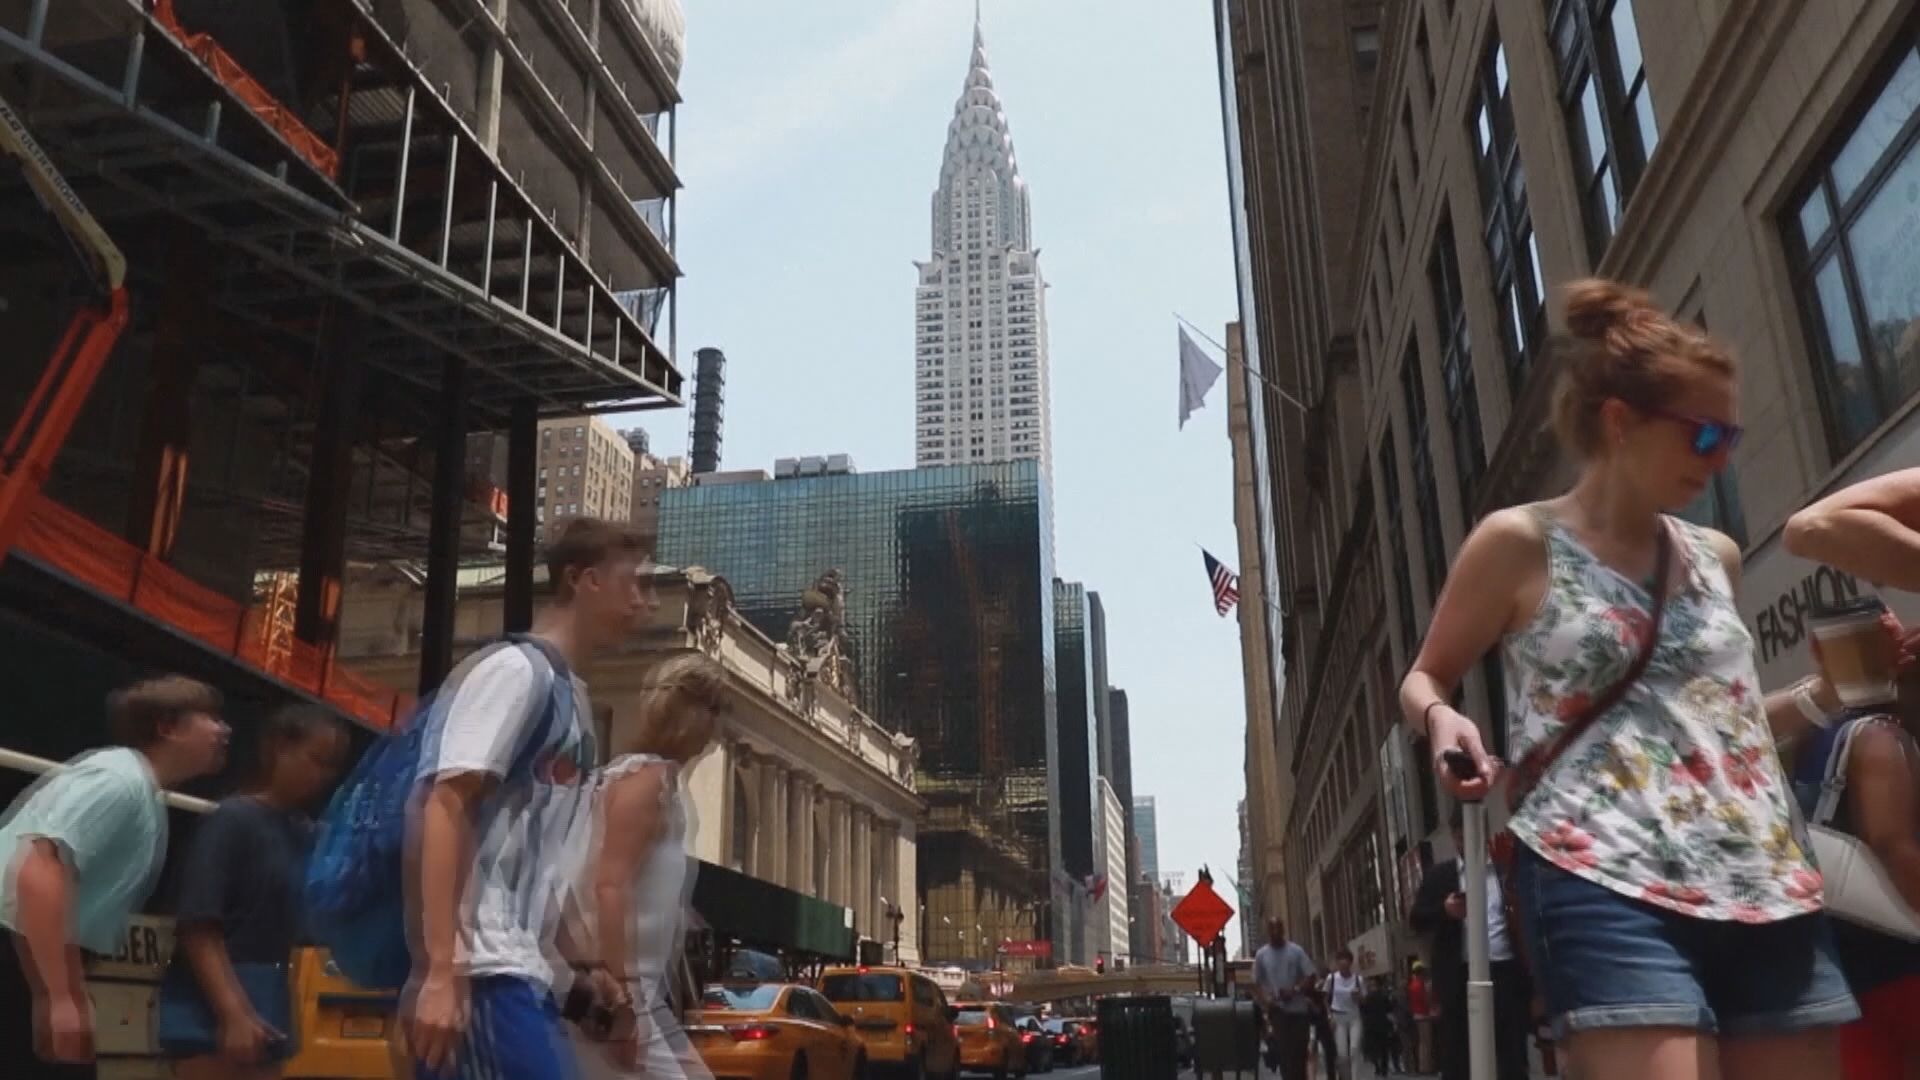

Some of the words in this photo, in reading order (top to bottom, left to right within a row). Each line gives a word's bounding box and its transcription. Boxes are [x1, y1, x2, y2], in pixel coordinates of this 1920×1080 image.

[20, 134, 53, 176] ULTRA
[54, 177, 85, 214] BOOM
[1757, 565, 1858, 664] FASHION
